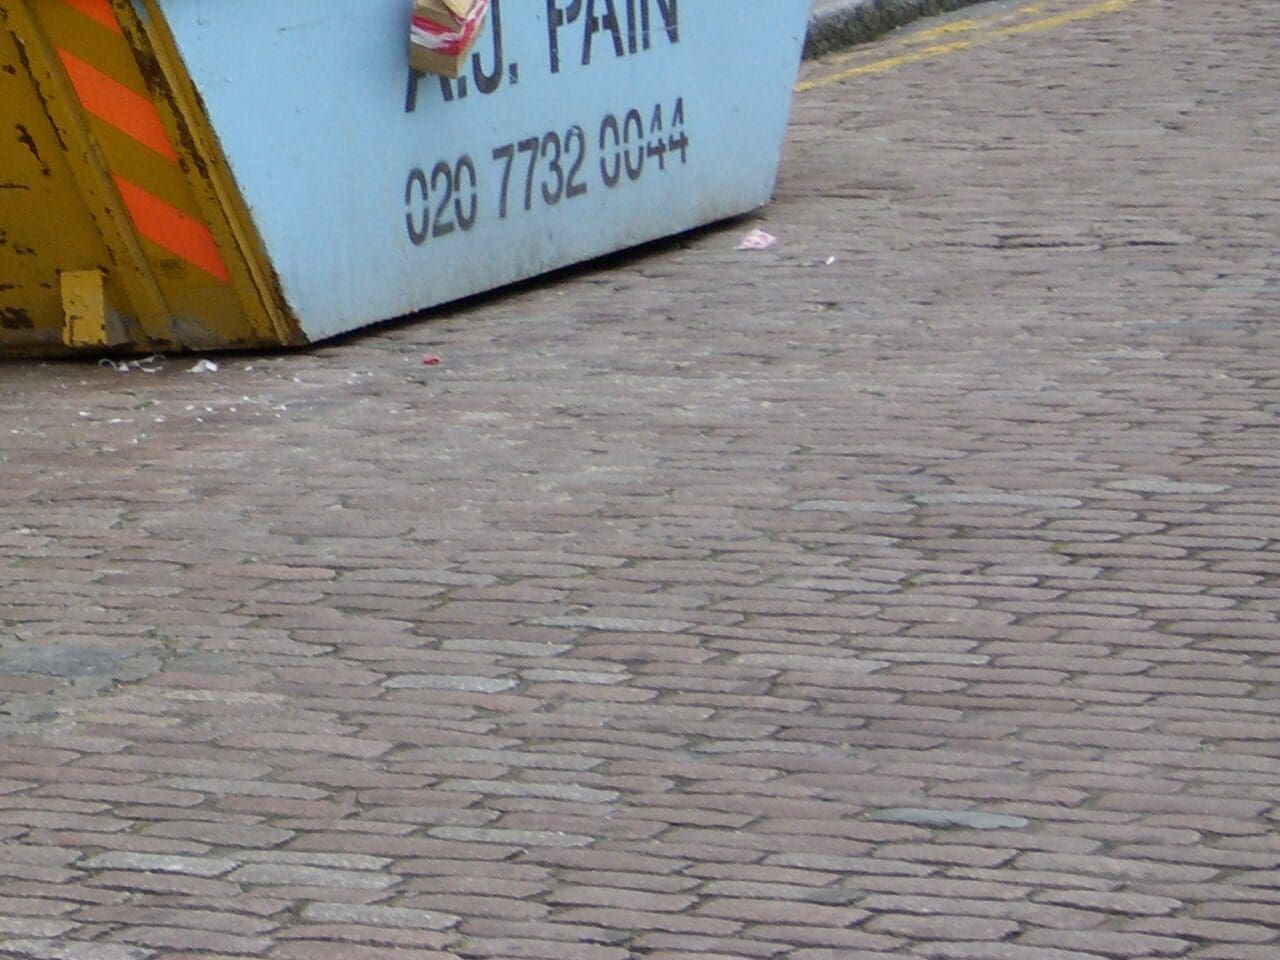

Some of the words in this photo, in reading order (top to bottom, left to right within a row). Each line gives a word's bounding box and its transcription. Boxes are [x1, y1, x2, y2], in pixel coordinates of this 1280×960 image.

[405, 154, 478, 246] 020
[492, 124, 588, 218] 7732
[599, 96, 690, 188] 0044
